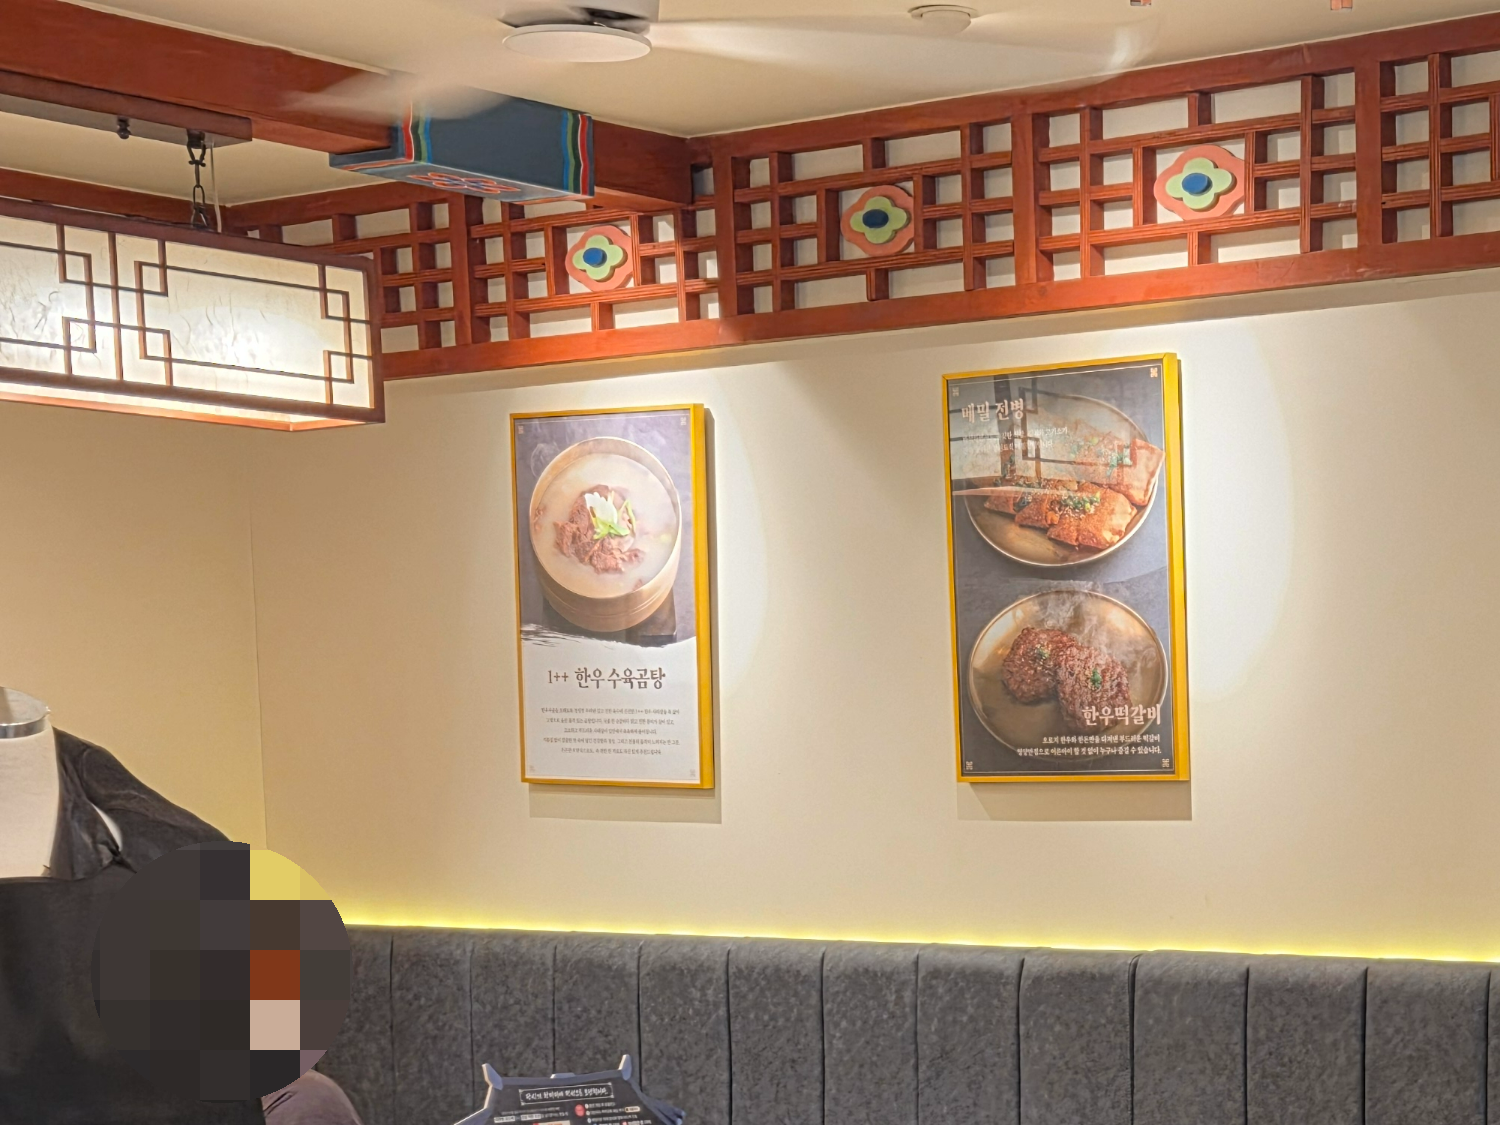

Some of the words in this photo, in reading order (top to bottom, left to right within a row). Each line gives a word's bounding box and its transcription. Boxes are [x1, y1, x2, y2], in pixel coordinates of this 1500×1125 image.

[994, 398, 1025, 421] 전병
[547, 670, 569, 684] 1++
[574, 667, 605, 690] 한우
[607, 667, 666, 690] 수육곰탕
[1082, 704, 1161, 726] 한우떡갈비
